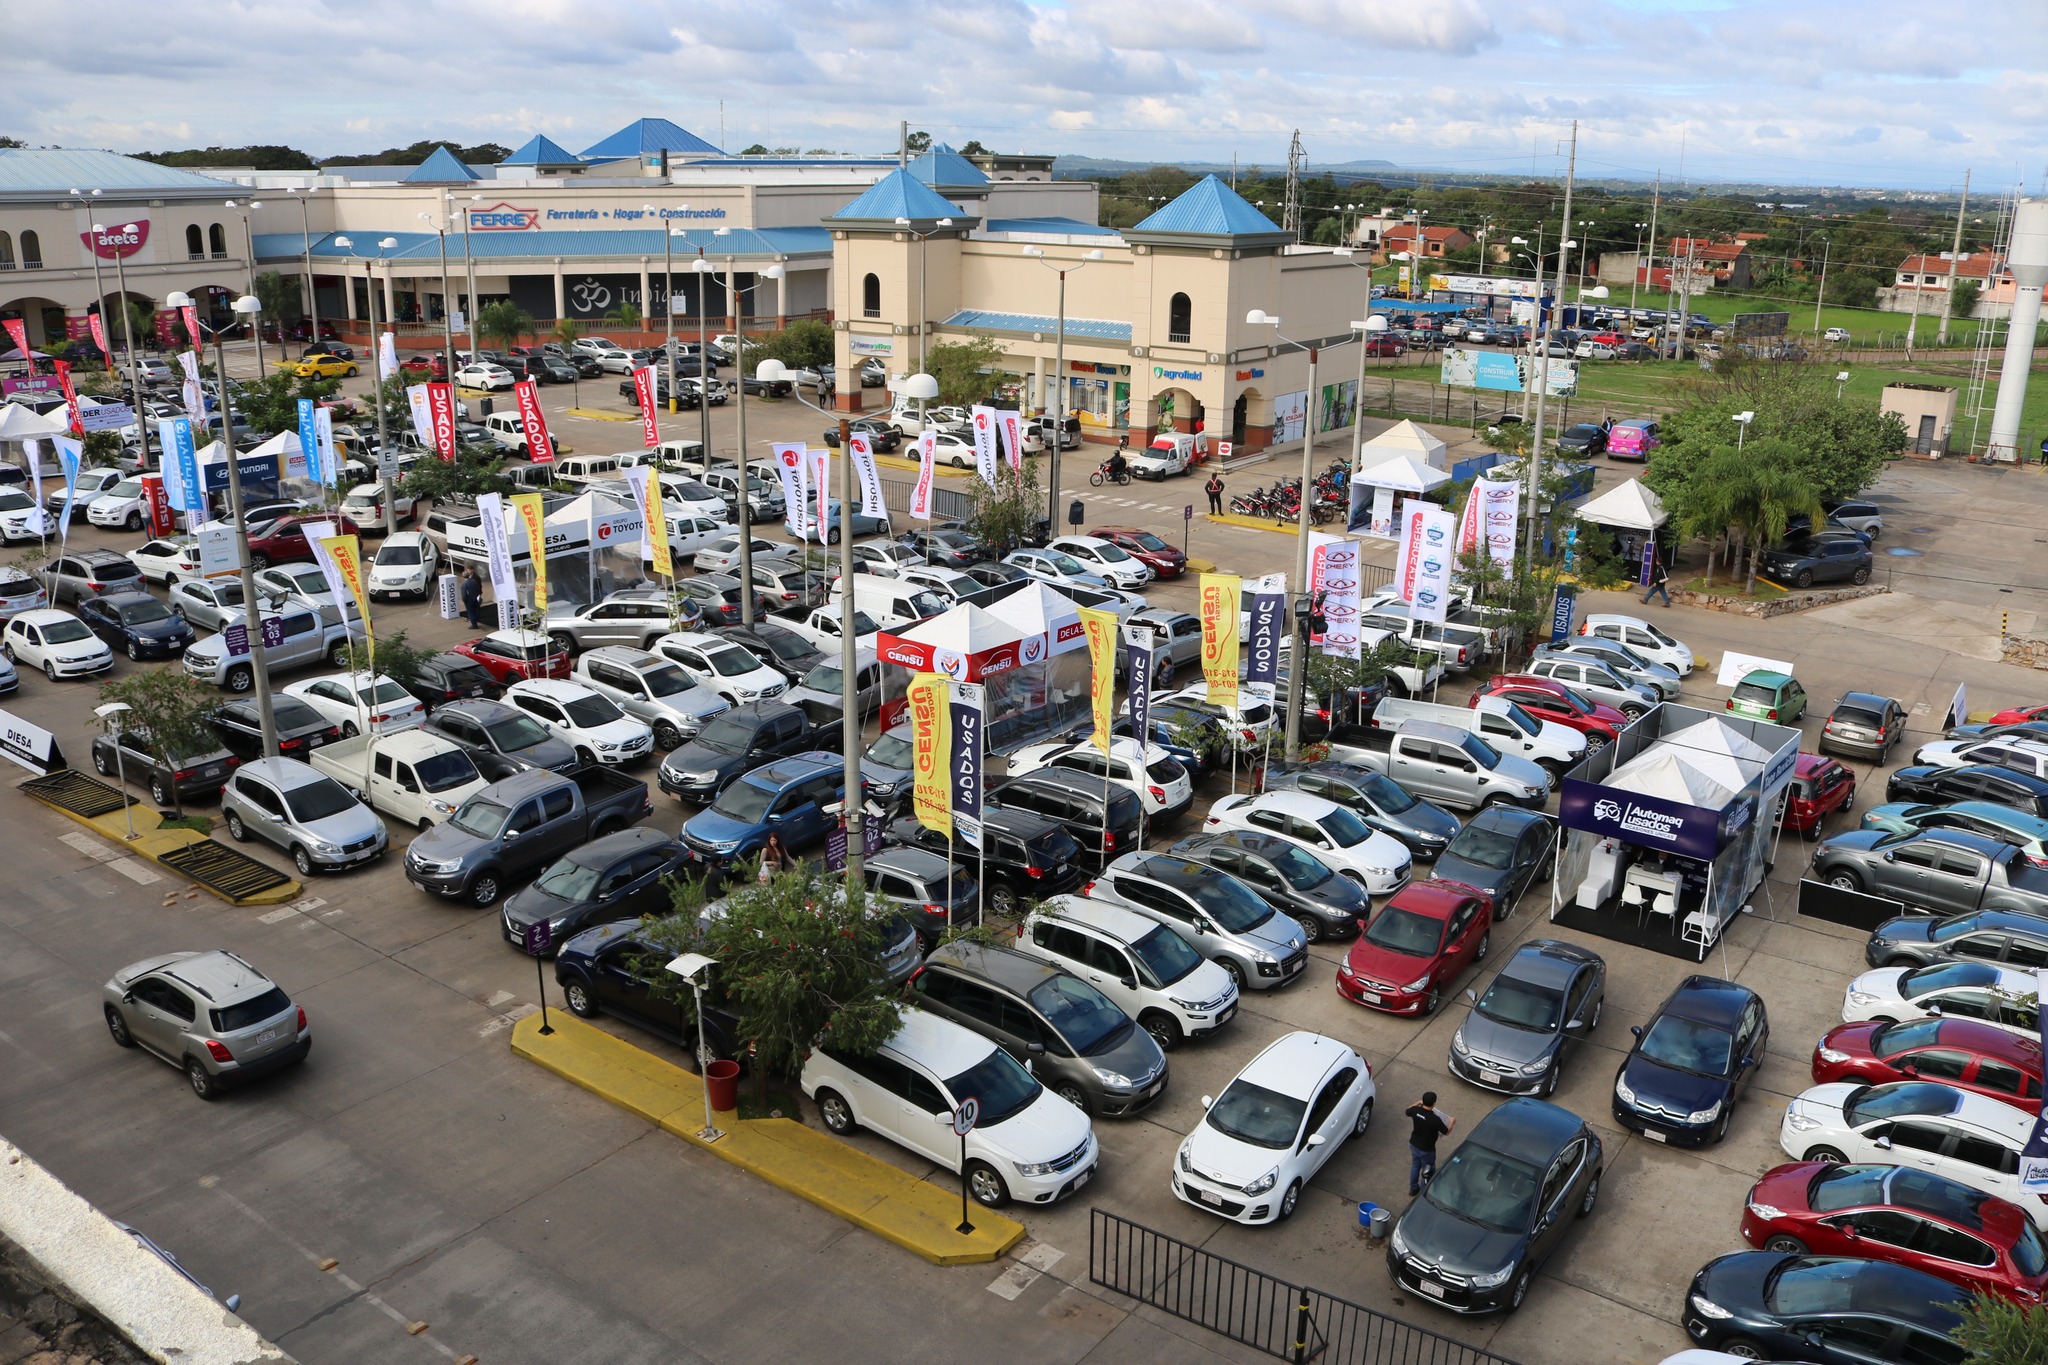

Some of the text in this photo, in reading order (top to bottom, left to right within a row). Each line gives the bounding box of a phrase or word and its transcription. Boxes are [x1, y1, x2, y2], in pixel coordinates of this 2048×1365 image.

[471, 213, 541, 229] FERREX
[547, 208, 726, 220] Ferretería Hogar Construcción
[669, 340, 677, 348] 10
[1163, 369, 1202, 381] agrofield
[1480, 367, 1514, 376] CONSTRUIR
[101, 405, 130, 416] USADOS
[637, 372, 655, 439] USADOS
[519, 386, 547, 455] USADOS
[385, 452, 391, 461] E
[861, 455, 878, 512] TOYOTOSHI
[157, 487, 169, 527] ISUZU
[789, 469, 804, 531] TOYOTOSHI
[613, 521, 643, 534] TOYOTO
[465, 535, 487, 547] DIES
[546, 534, 567, 544] ESA
[1555, 597, 1569, 633] USADOS
[268, 630, 280, 639] 03
[1255, 601, 1275, 672] USADOS
[888, 652, 924, 667] CENSU
[981, 659, 1012, 675] CENSU
[7, 729, 32, 749] DIESA
[960, 714, 975, 805] USADOS
[1627, 815, 1671, 832] usados
[1631, 806, 1683, 829] Automaq
[867, 829, 878, 842] 02
[1625, 824, 1653, 835] OCASIONES
[959, 1102, 974, 1125] 10
